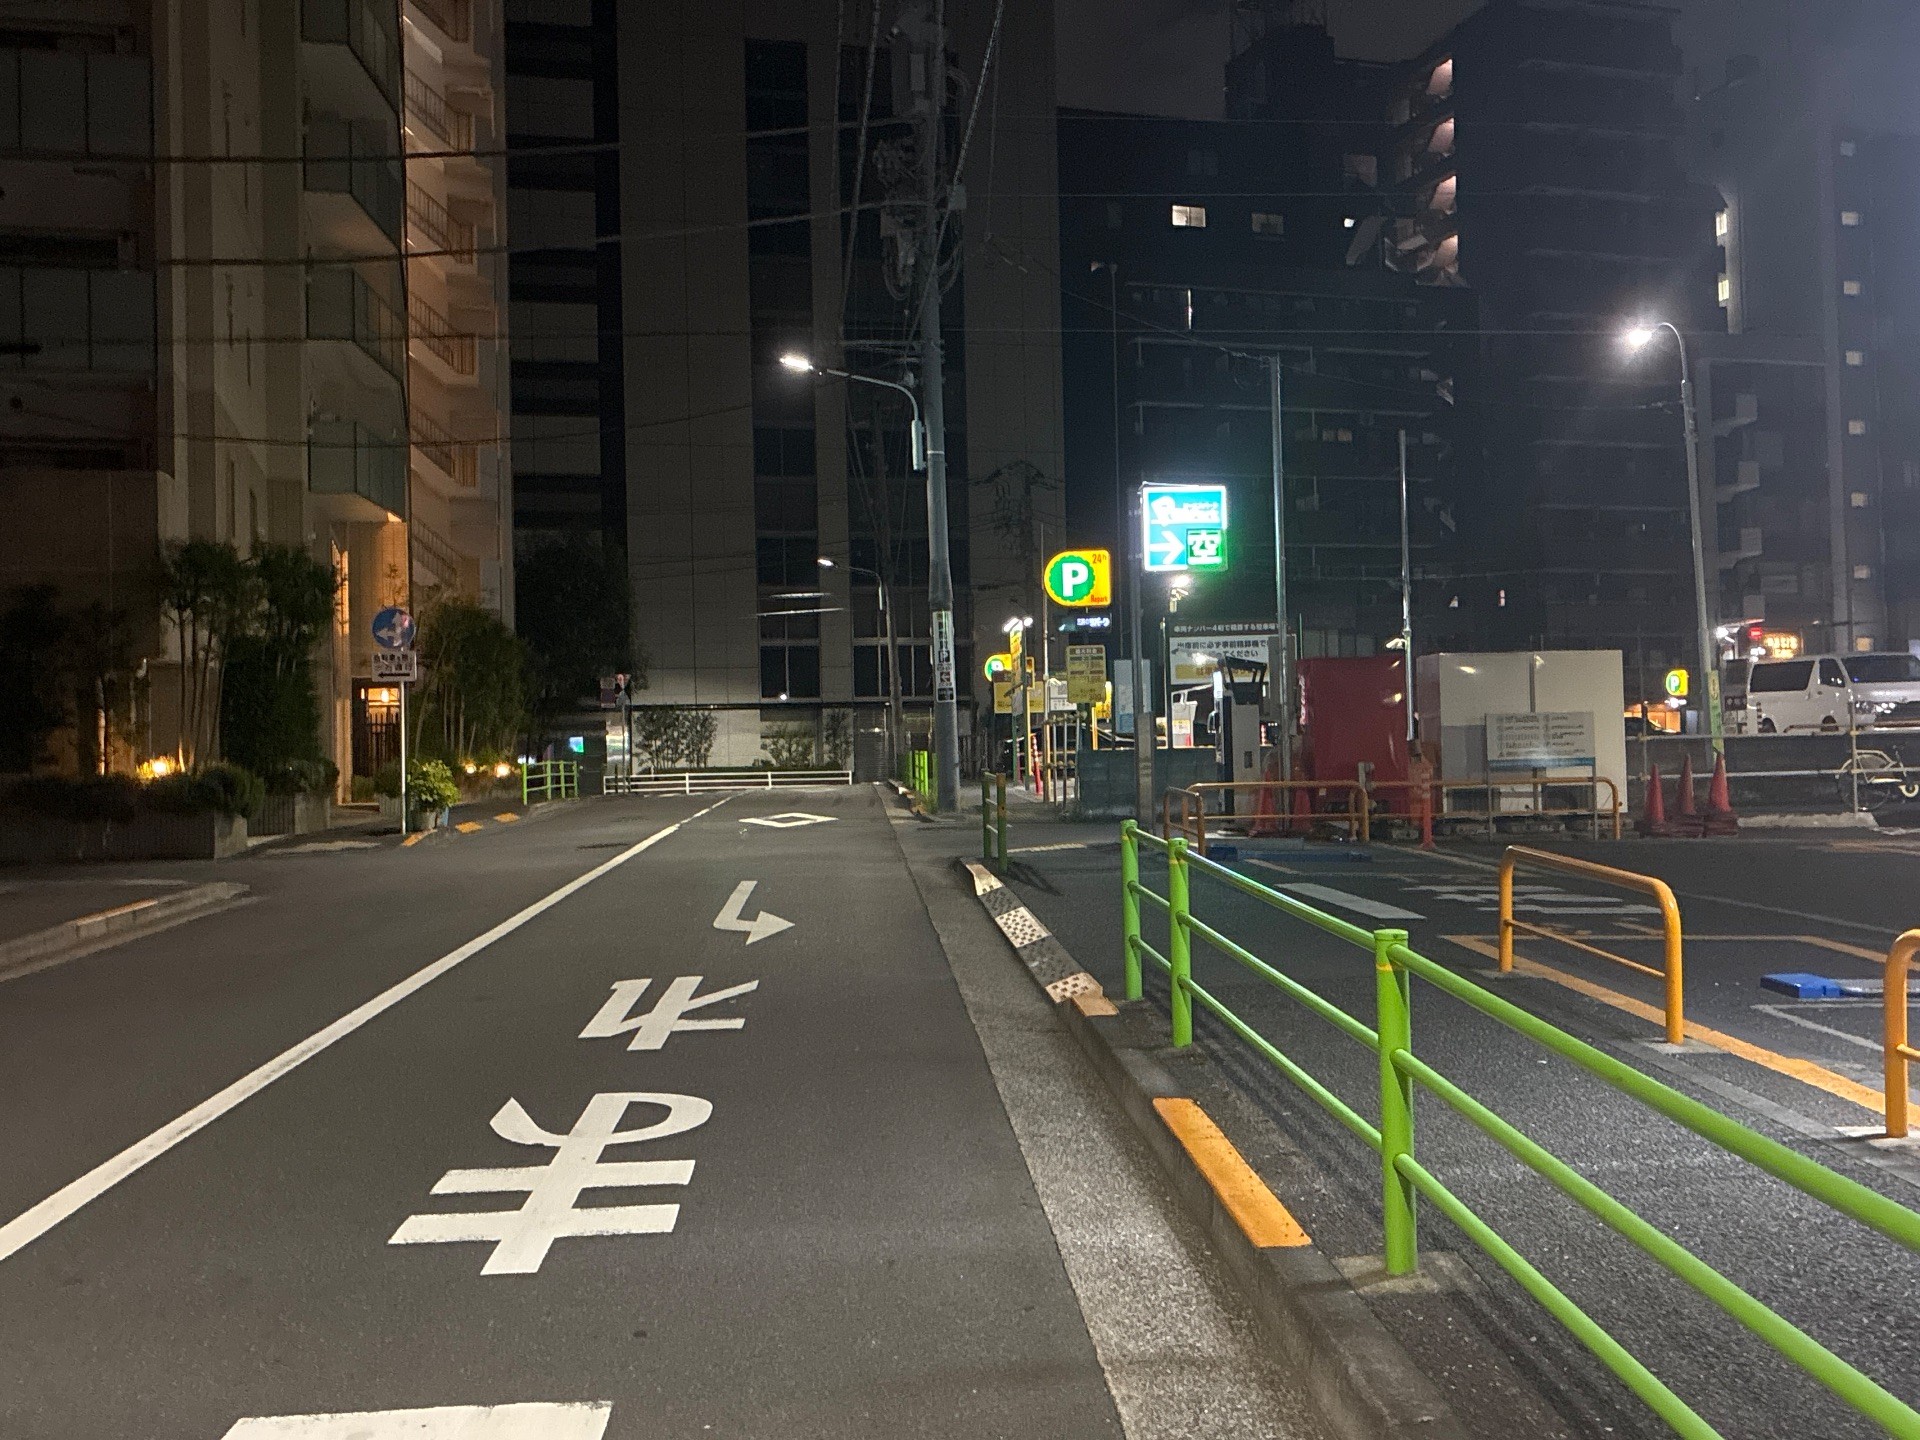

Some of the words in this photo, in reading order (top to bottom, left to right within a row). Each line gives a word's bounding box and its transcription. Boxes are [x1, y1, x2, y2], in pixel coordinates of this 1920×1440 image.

[1187, 529, 1223, 566] 空
[1062, 562, 1089, 598] P
[1670, 675, 1680, 692] P
